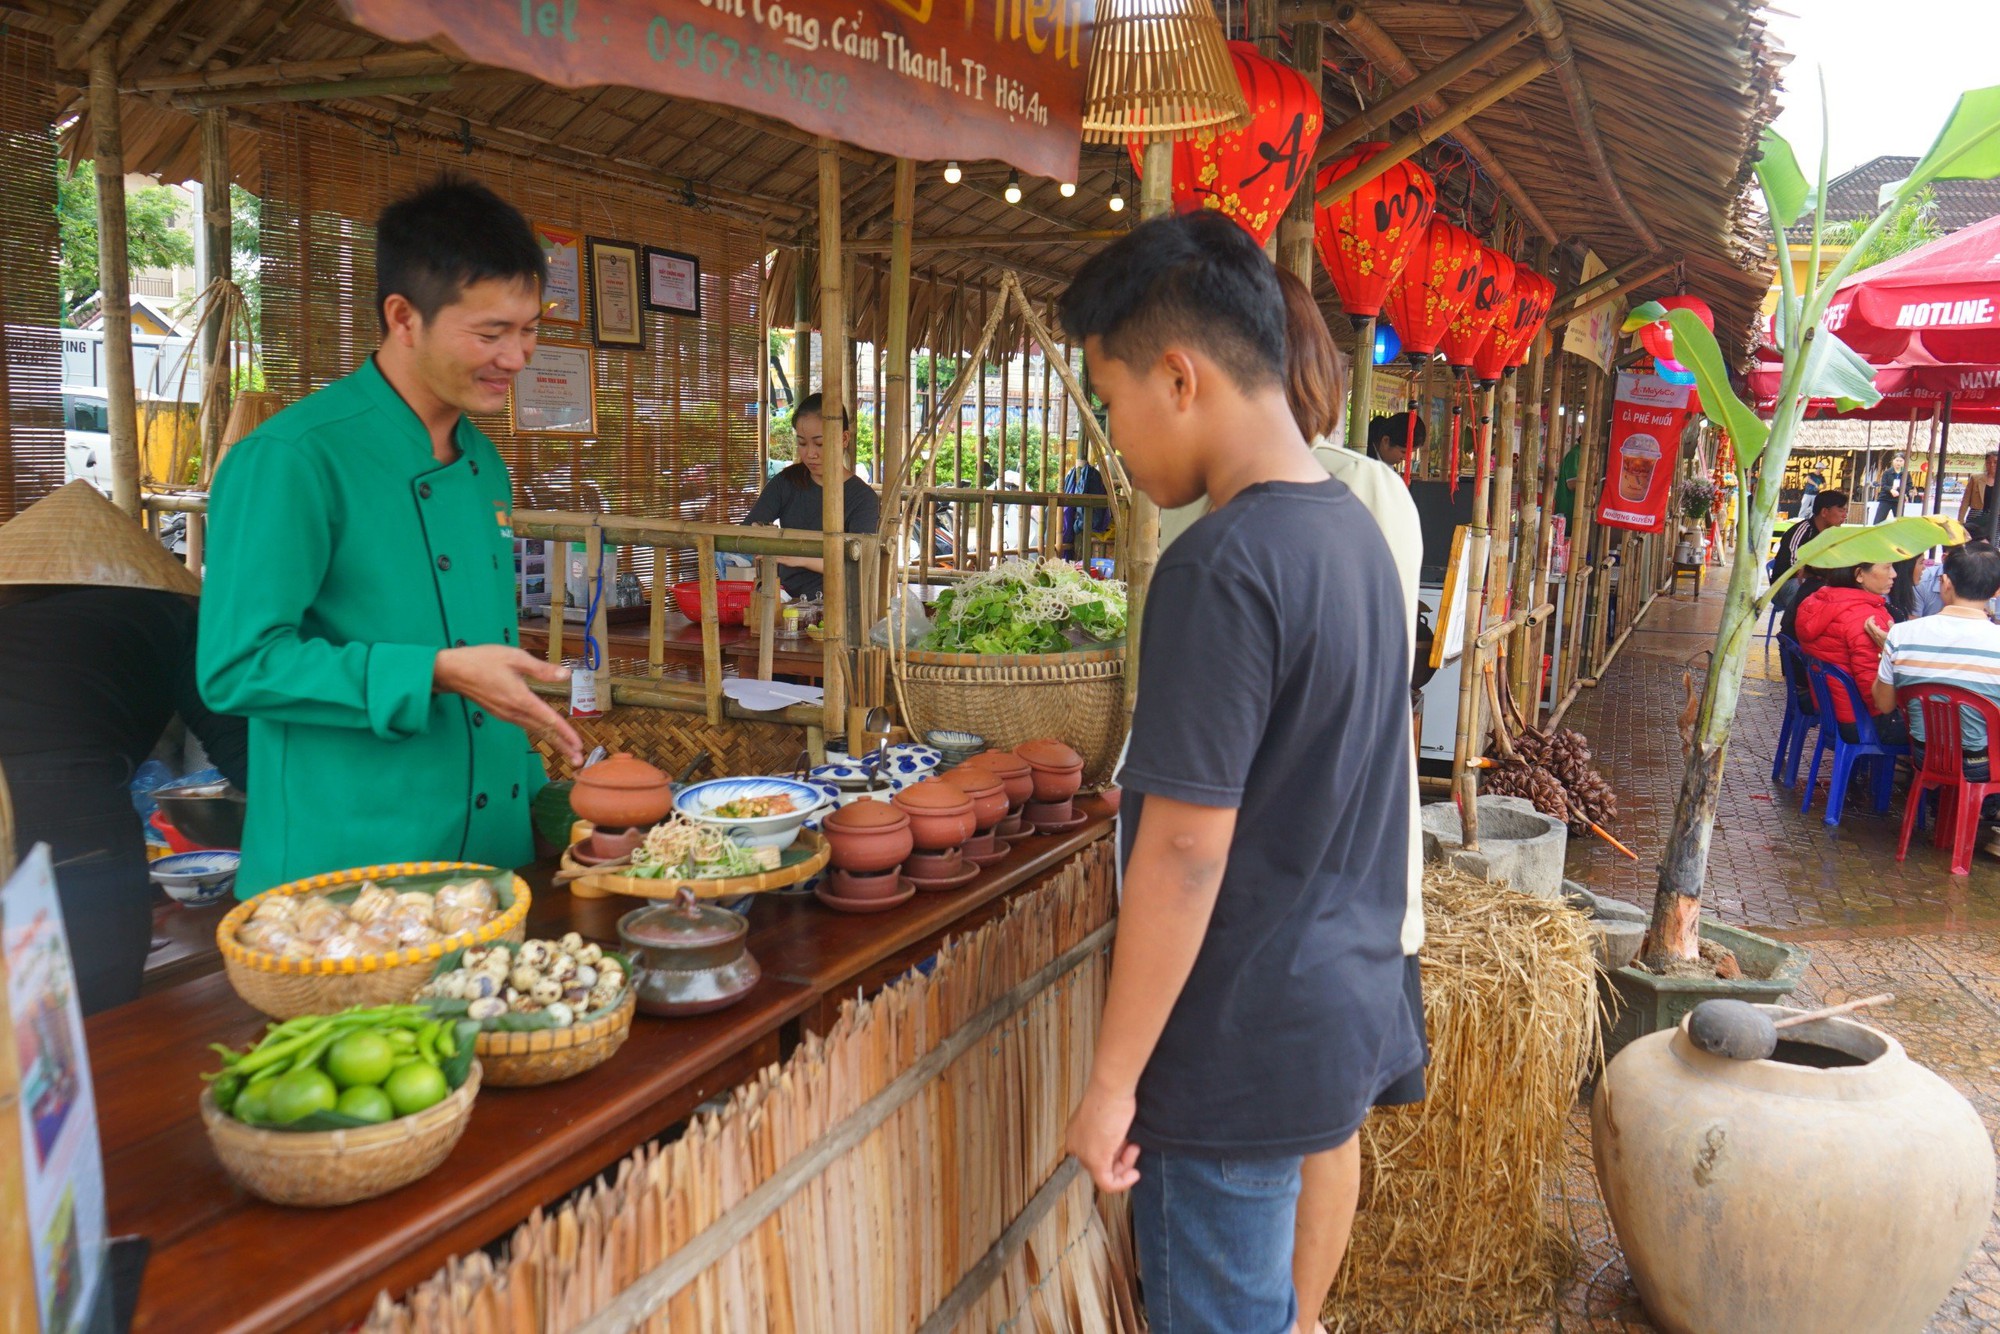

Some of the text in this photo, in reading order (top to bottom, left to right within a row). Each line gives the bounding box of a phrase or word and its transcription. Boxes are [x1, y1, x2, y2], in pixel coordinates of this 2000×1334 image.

[995, 74, 1025, 123] Hội
[1026, 92, 1048, 127] An
[1896, 298, 1995, 327] HOTLINE:
[1622, 409, 1672, 426] CÀ PHÊ MUỐI
